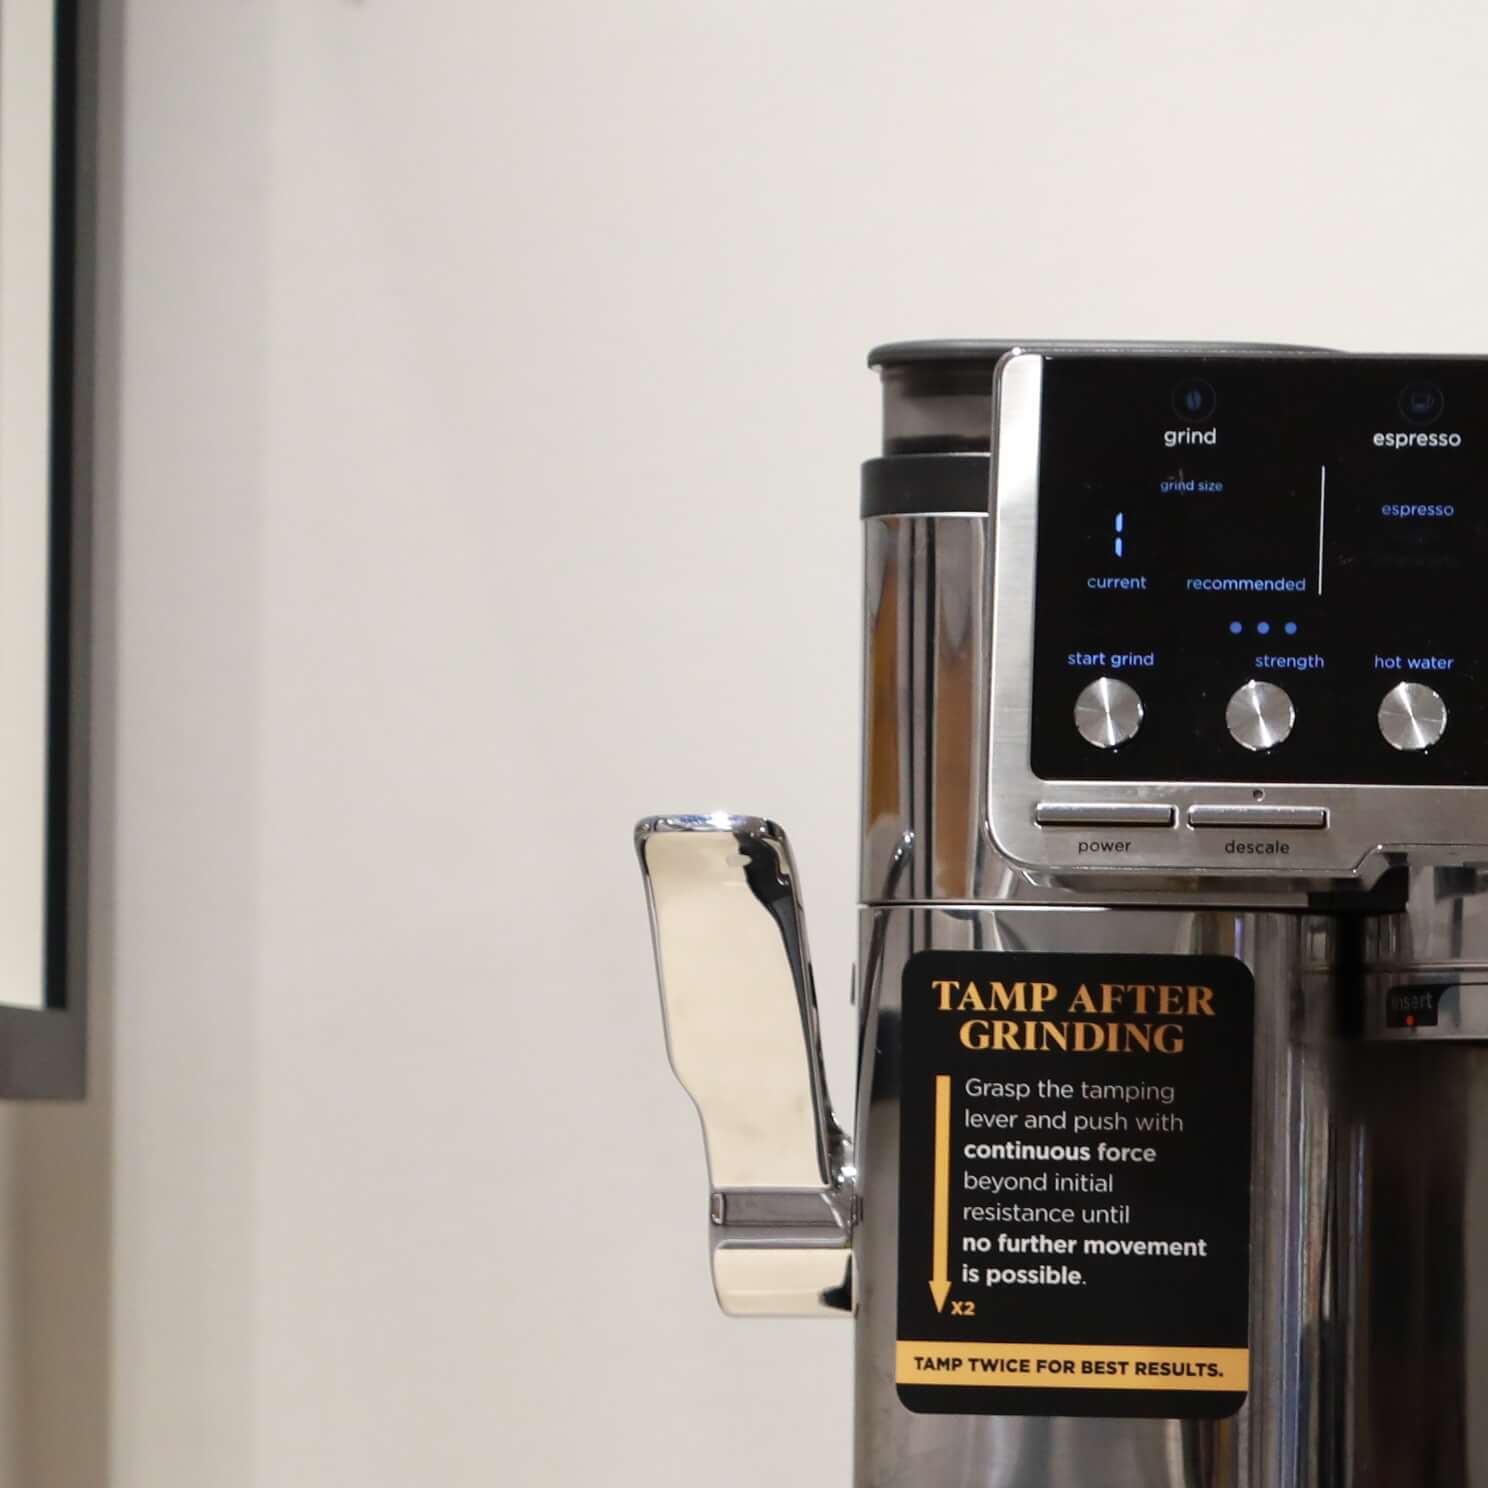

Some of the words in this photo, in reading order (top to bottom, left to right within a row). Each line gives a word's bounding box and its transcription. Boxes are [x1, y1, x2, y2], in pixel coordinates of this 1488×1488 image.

[1163, 427, 1217, 448] grind
[1372, 432, 1462, 449] espresso
[1160, 478, 1195, 494] grind
[1197, 478, 1224, 492] size
[1381, 504, 1455, 518] espresso
[1087, 576, 1147, 590] current
[1186, 577, 1306, 592] recommended
[1067, 652, 1106, 666] start
[1110, 652, 1155, 669] grind
[1255, 654, 1325, 671] strength
[1374, 655, 1402, 669] hot
[1407, 656, 1454, 670] water
[1078, 840, 1132, 855] power
[1224, 839, 1290, 855] descale
[931, 980, 1058, 1013] TAMP
[1068, 983, 1215, 1016] AFTER
[959, 1019, 1183, 1053] GRINDING
[965, 1077, 1031, 1101] Grasp
[1037, 1079, 1074, 1099] the
[1080, 1081, 1175, 1105] tamping
[965, 1108, 1019, 1129] lever
[1024, 1110, 1067, 1130] and
[1073, 1111, 1128, 1134] push
[1135, 1112, 1184, 1132] with
[963, 1140, 1091, 1161] continuous
[1097, 1141, 1157, 1163] force
[963, 1170, 1048, 1194] beyond
[1055, 1172, 1113, 1193] initial
[963, 1202, 1075, 1223] resistance
[1081, 1204, 1130, 1224] until
[962, 1236, 992, 1252] no
[997, 1232, 1078, 1254] further
[1083, 1238, 1207, 1257] movement
[962, 1263, 980, 1283] is
[986, 1264, 1087, 1287] possible.
[951, 1300, 975, 1316] X2
[913, 1356, 963, 1372] TAMP
[967, 1357, 1031, 1374] TWICE
[1036, 1359, 1076, 1374] FOR
[1081, 1360, 1130, 1376] BEST
[1134, 1361, 1224, 1378] RESULTS.
